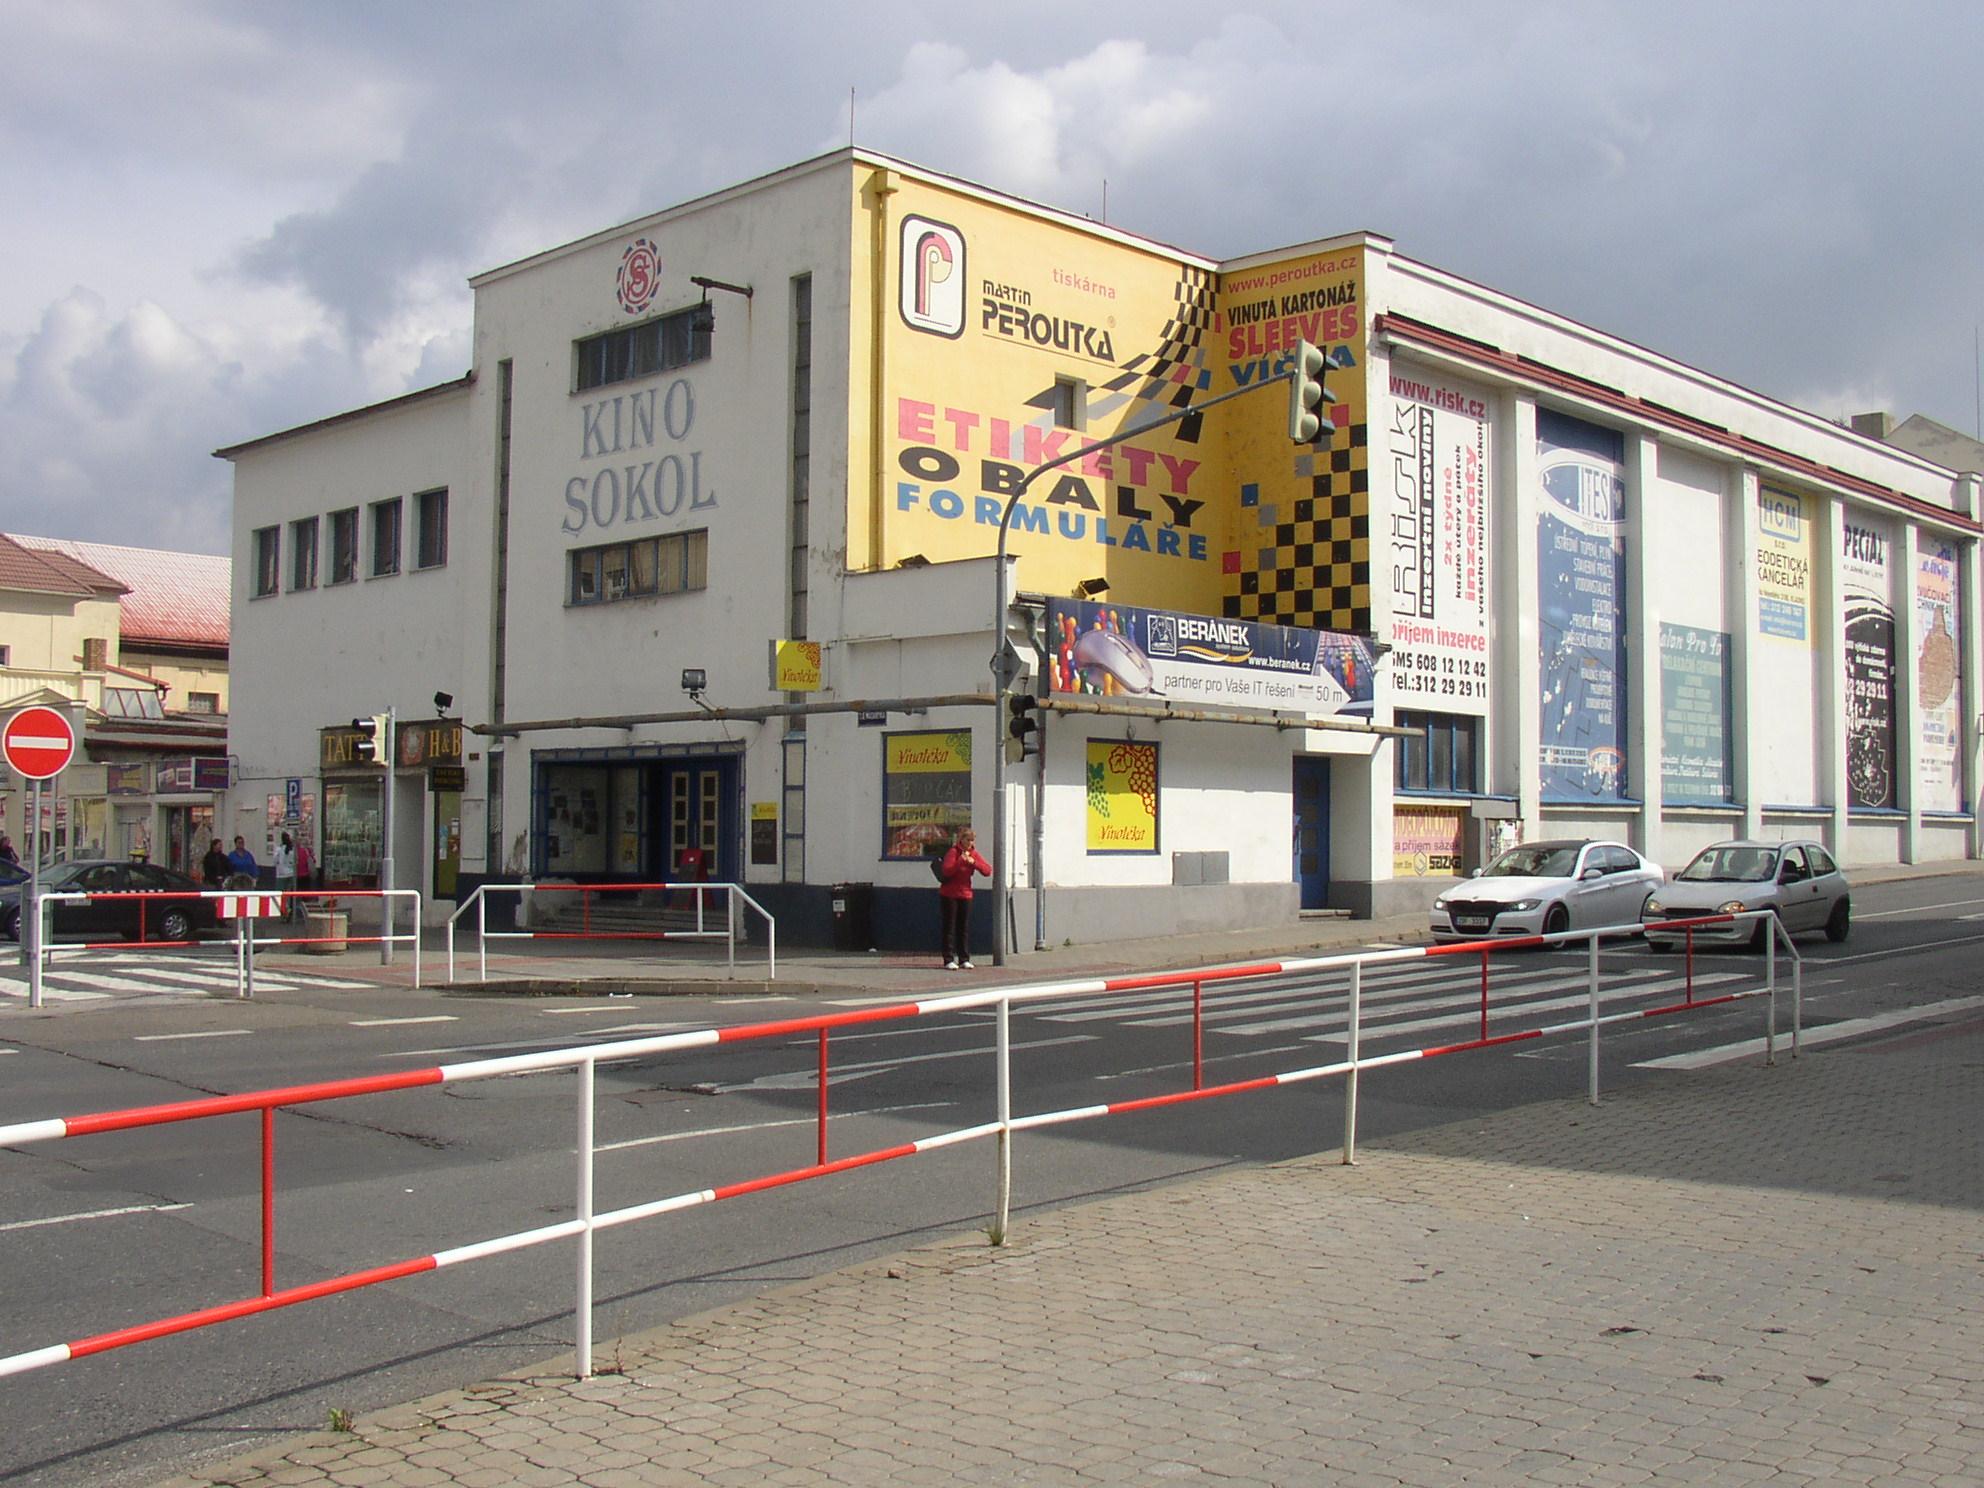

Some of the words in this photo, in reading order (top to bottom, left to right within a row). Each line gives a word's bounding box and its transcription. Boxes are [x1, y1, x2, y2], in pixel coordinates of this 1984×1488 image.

[1053, 268, 1116, 299] tiskárna
[1228, 256, 1357, 294] www.peroutka.cz
[1227, 296, 1277, 326] VINUTÁ
[1281, 280, 1356, 316] KARTONÁŽ
[983, 298, 1115, 362] PEROUTKA
[1228, 304, 1358, 360] SLEEVES
[1228, 345, 1356, 387] VÍČA
[1389, 375, 1485, 418] www.risk.cz
[580, 378, 697, 460] KINO
[897, 397, 1201, 495] ETIKETY
[1420, 411, 1433, 502] noviny
[561, 450, 719, 536] SOKOL
[898, 446, 1205, 527] OBALY
[897, 481, 1208, 562] FORMULÁŘE
[1389, 402, 1416, 617] Risk
[1464, 444, 1477, 601] inzeráty
[1763, 498, 1797, 531] HCM
[1444, 540, 1453, 566] 2x
[1758, 549, 1808, 574] EODETICKÁ
[1177, 619, 1250, 646] BERÁNEK
[1437, 626, 1485, 652] inzerce
[1248, 656, 1311, 671] www.beranek.cz
[1416, 653, 1437, 672] 608
[1442, 657, 1454, 673] 12
[1459, 659, 1470, 675] 12
[1473, 661, 1486, 677] 42
[1164, 674, 1202, 692] partner
[1205, 680, 1222, 695] pro
[1225, 678, 1249, 694] Vaše
[1253, 681, 1263, 695] IT
[1265, 682, 1295, 698] řešení
[1316, 686, 1329, 701] 50
[1333, 690, 1343, 702] m
[1441, 678, 1455, 695] 29
[1459, 680, 1472, 697] 29
[1475, 681, 1486, 698] 11
[429, 727, 462, 758] H&B
[898, 748, 949, 766] Vinotéka
[1099, 825, 1146, 842] Vinotéka
[1402, 839, 1431, 853] příjem
